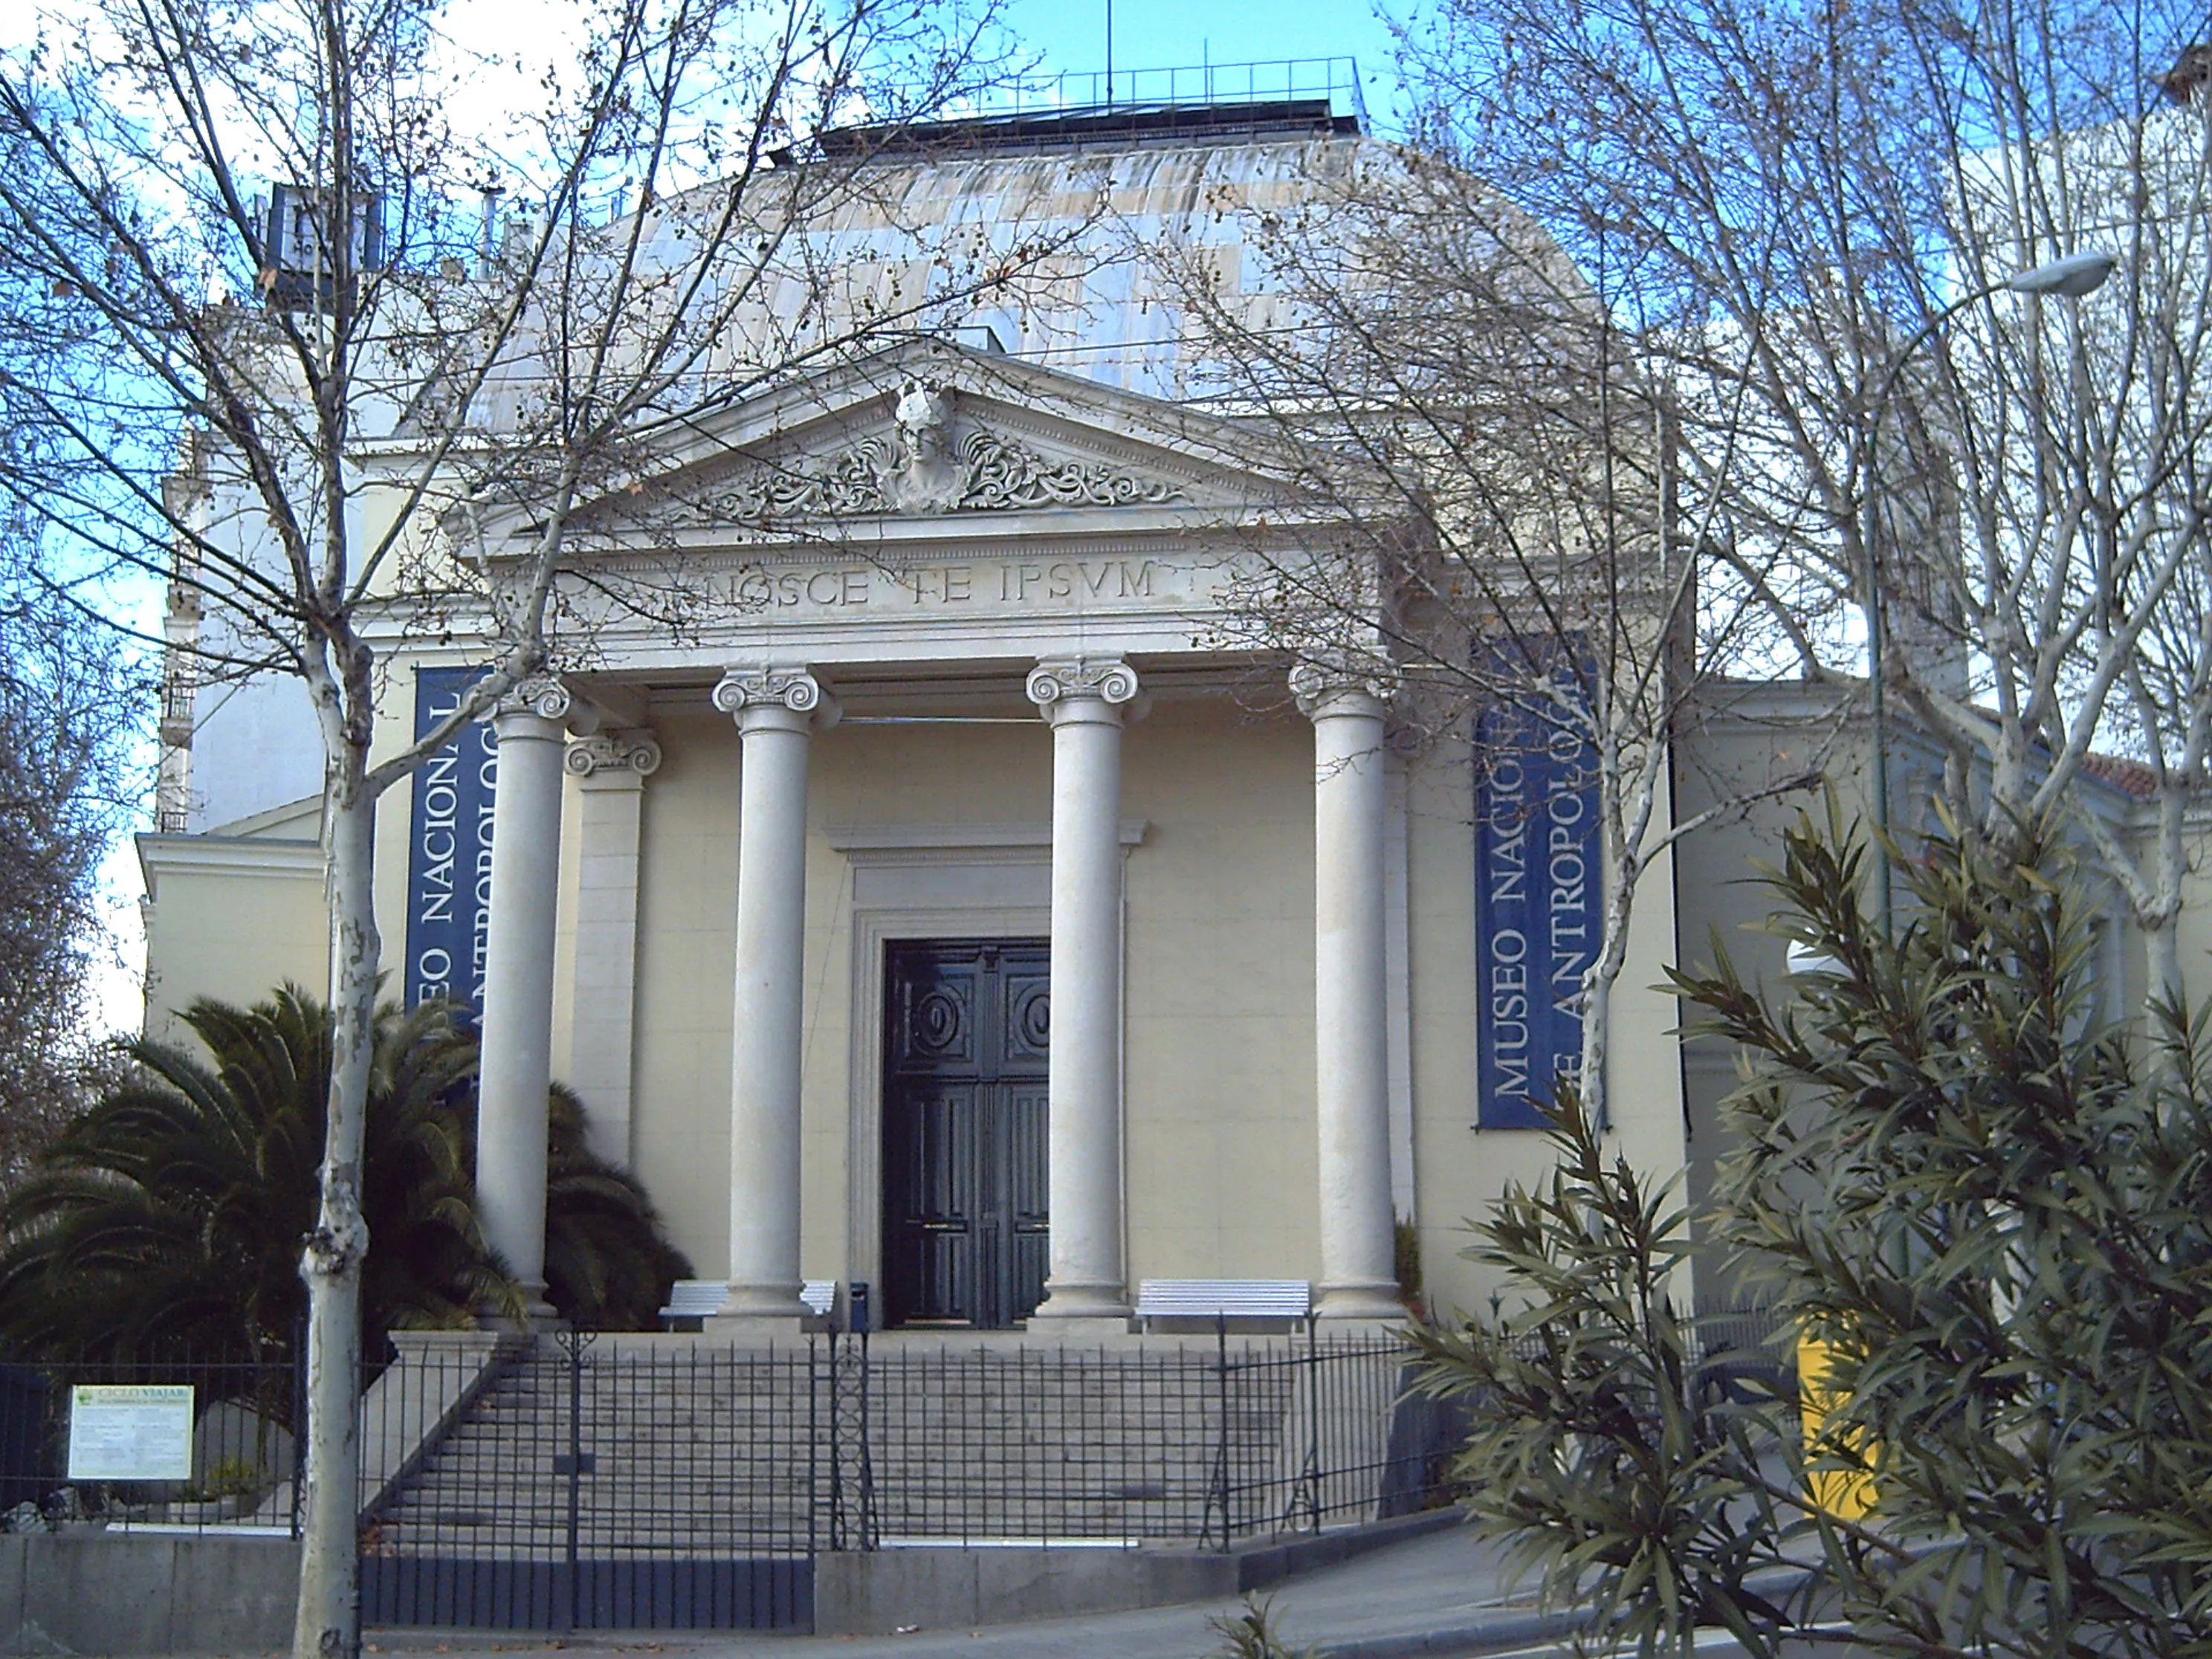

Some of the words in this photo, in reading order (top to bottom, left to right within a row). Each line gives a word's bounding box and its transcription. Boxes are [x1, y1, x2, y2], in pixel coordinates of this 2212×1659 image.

[703, 570, 869, 610] NOSCE
[902, 566, 971, 604] TE
[1000, 560, 1157, 601] IPSVM
[421, 693, 462, 923] NACIONL
[1490, 675, 1530, 904] NACIONA
[1547, 656, 1585, 1020] ANTROPOLOG
[1492, 928, 1529, 1098] MUSEO
